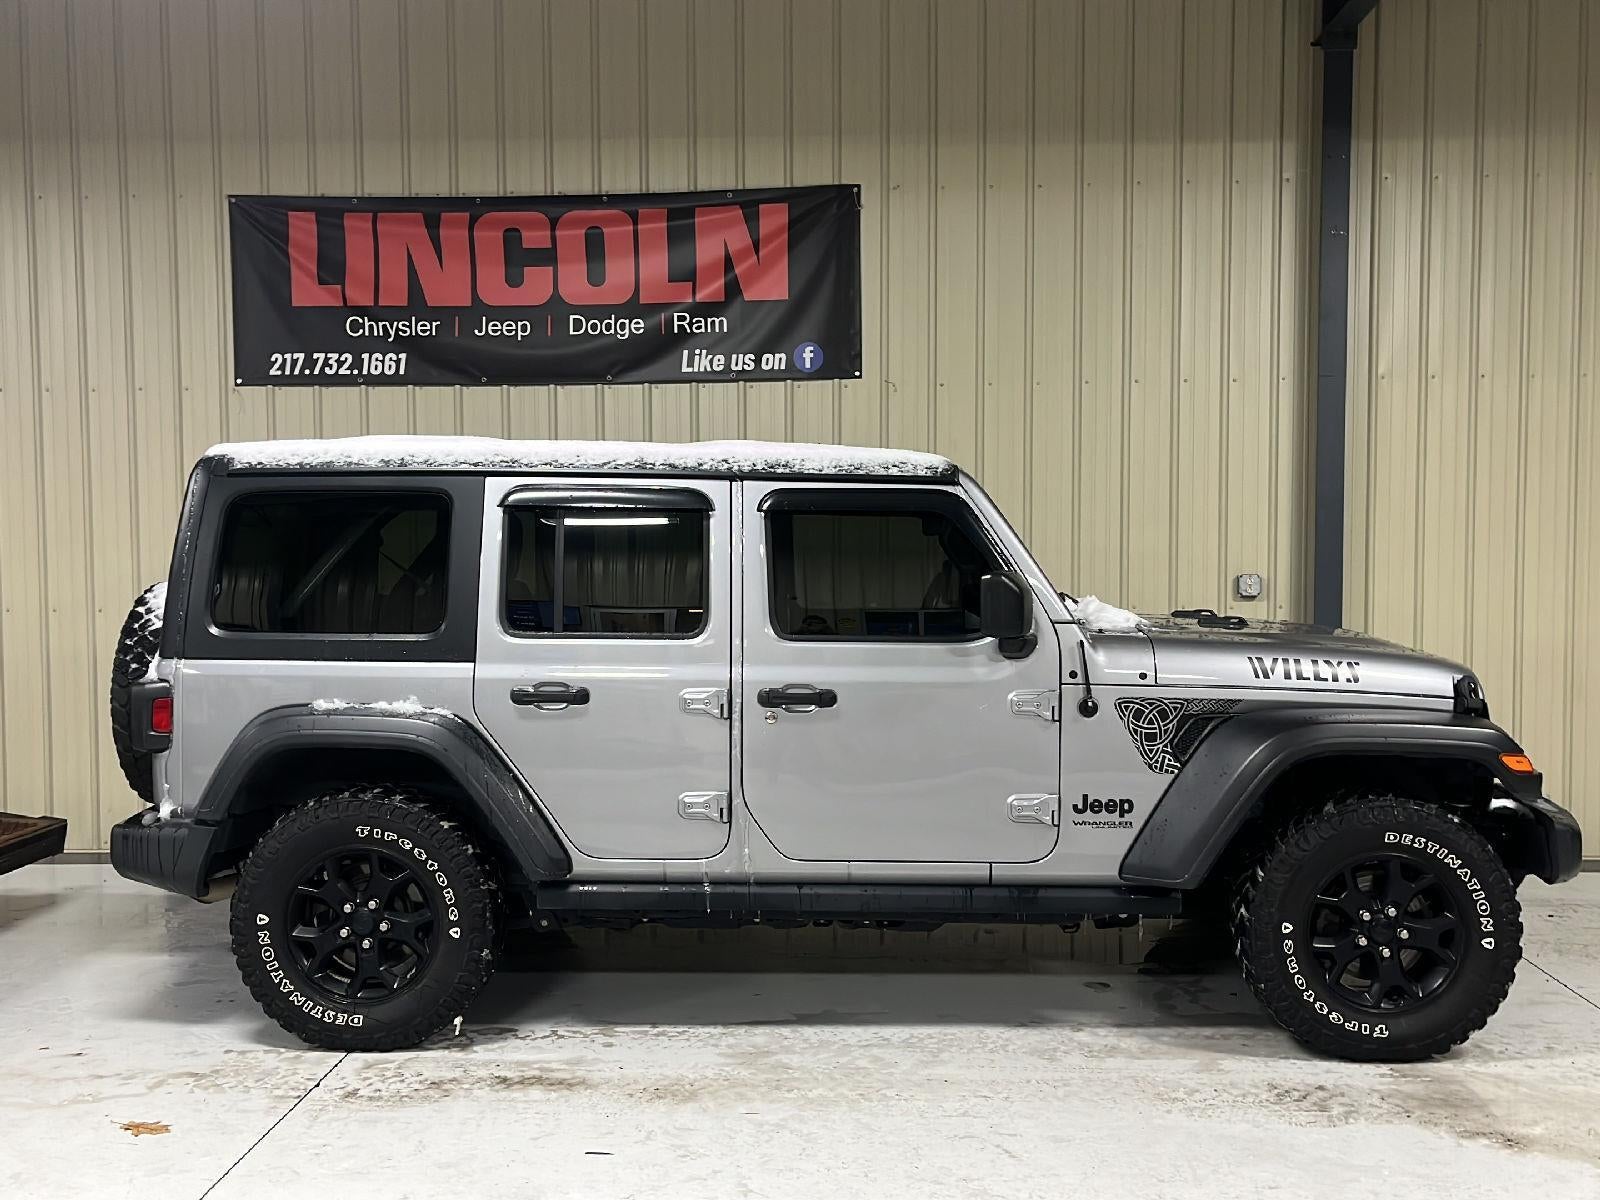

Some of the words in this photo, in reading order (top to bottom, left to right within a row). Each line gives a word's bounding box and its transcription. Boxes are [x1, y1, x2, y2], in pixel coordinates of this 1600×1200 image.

[287, 203, 789, 307] LINCOLN
[345, 316, 441, 342] Chrysler
[474, 316, 531, 340] Jeep
[569, 314, 645, 339] Dodge
[672, 312, 728, 334] Ram
[269, 352, 407, 375] 217.732.1661
[681, 349, 725, 372] Like
[730, 351, 755, 371] us
[761, 351, 786, 370] on
[1247, 656, 1360, 683] WILLYS
[1072, 793, 1135, 818] Jeep
[1385, 832, 1495, 932] DESTINATION
[257, 931, 364, 1027] DESTINATION
